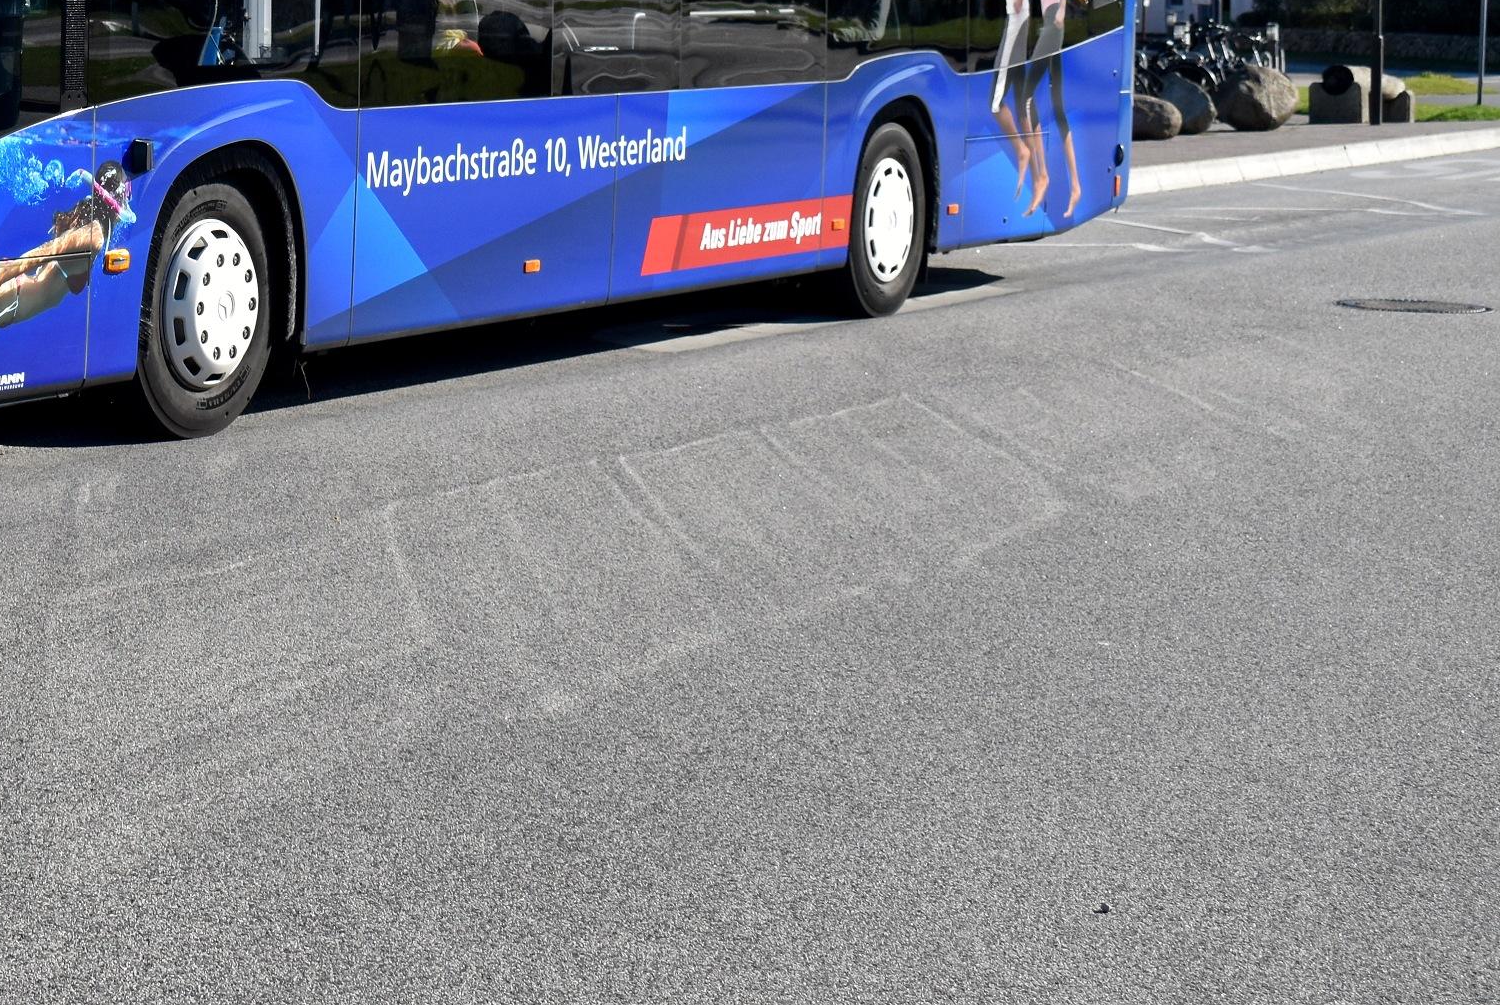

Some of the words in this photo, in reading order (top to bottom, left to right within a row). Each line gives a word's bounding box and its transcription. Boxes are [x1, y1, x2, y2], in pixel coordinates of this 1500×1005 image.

[366, 137, 537, 197] Maybachstraße
[544, 137, 572, 178] 10,
[578, 126, 687, 168] Westerland
[700, 221, 726, 251] Aus
[728, 216, 762, 248] Liebe
[763, 218, 789, 242] zum
[790, 210, 822, 245] Sport
